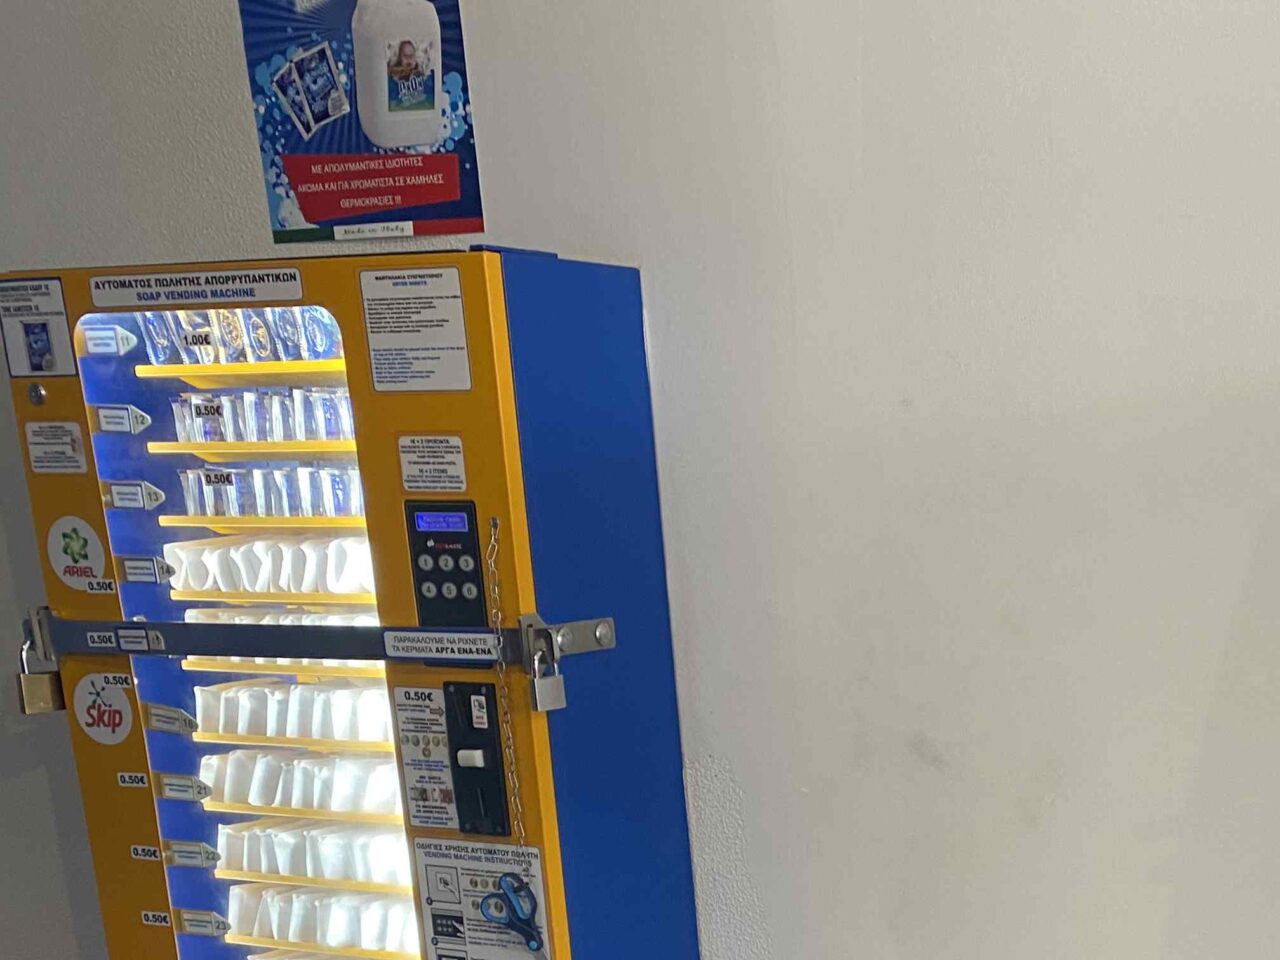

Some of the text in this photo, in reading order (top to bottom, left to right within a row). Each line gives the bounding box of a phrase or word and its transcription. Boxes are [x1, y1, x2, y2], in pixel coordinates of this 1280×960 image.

[312, 165, 322, 174] ΜΕ
[325, 182, 337, 190] ΚΑΙ
[395, 177, 404, 186] ΣΕ
[406, 174, 444, 184] ΧΑΜΗΛΕΣ
[94, 272, 297, 290] ΑΥΤΟΜΑΤΟΣ ΠΩΛΗΤΗΣ ΑΠΟΡΡΥΠΑΝΤΙΚΩΝ
[136, 288, 255, 301] SOAP VENDING MACHINE
[183, 334, 210, 346] 1.00€
[195, 406, 222, 417] 0.50€
[135, 415, 145, 425] 12
[205, 474, 233, 485] 0.50€
[63, 565, 98, 578] ARIEL
[88, 581, 113, 592] 0.50€
[89, 634, 113, 644] 0.50€
[394, 636, 445, 645] ΠΑΡΑΚΑΛΟΥΜΕ
[104, 676, 130, 686] 0.50€
[405, 691, 433, 701] 0.50€
[85, 704, 123, 734] Skip
[120, 774, 146, 785] 0.50€
[133, 847, 158, 858] 0.50€
[416, 842, 509, 857] ΟΔΗΓΙΕΣ ΧΡΗΣΗΣ ΑΥΤΟΜΑΤΟΥ
[424, 851, 452, 859] VENDING
[454, 854, 483, 862] MACHINE
[144, 914, 168, 924] 0.50€
